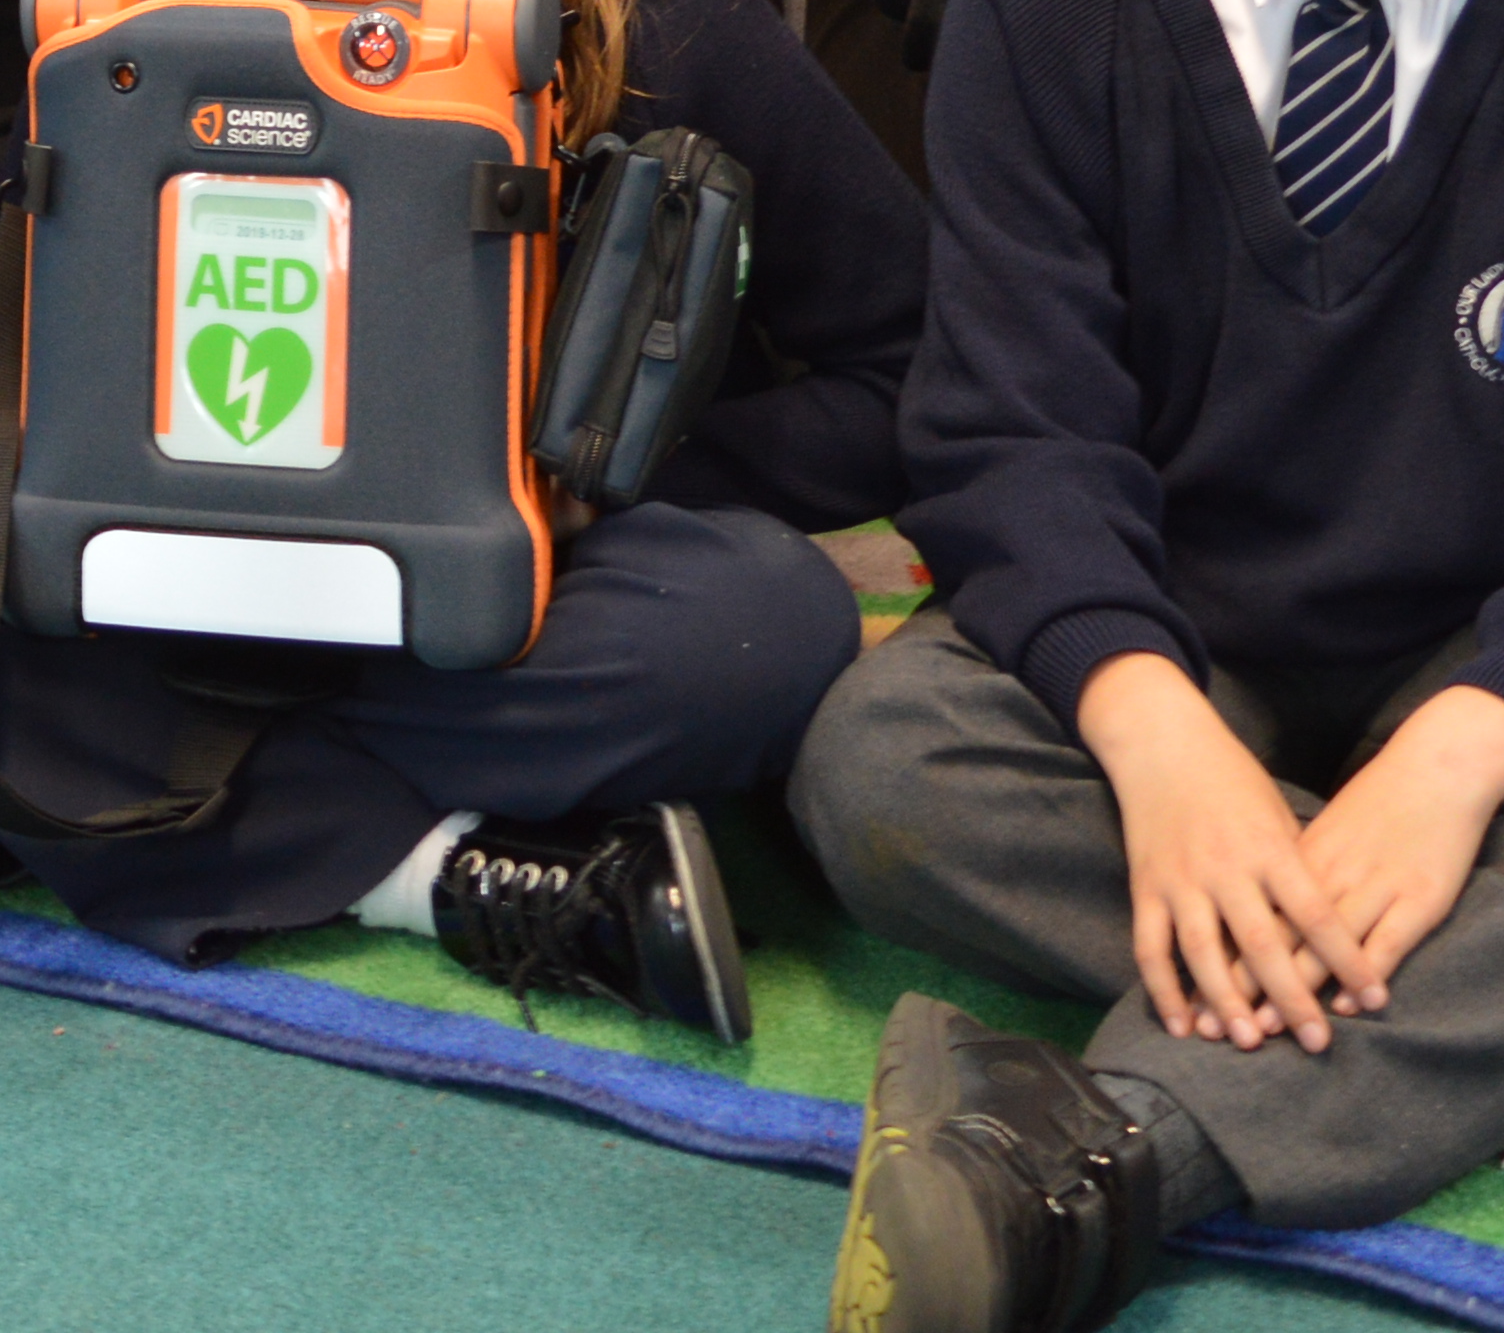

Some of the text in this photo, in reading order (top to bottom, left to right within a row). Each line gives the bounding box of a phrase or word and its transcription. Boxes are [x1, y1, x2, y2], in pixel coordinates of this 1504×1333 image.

[227, 109, 308, 130] CARDIAC
[227, 128, 308, 149] science
[185, 253, 319, 314] AED
